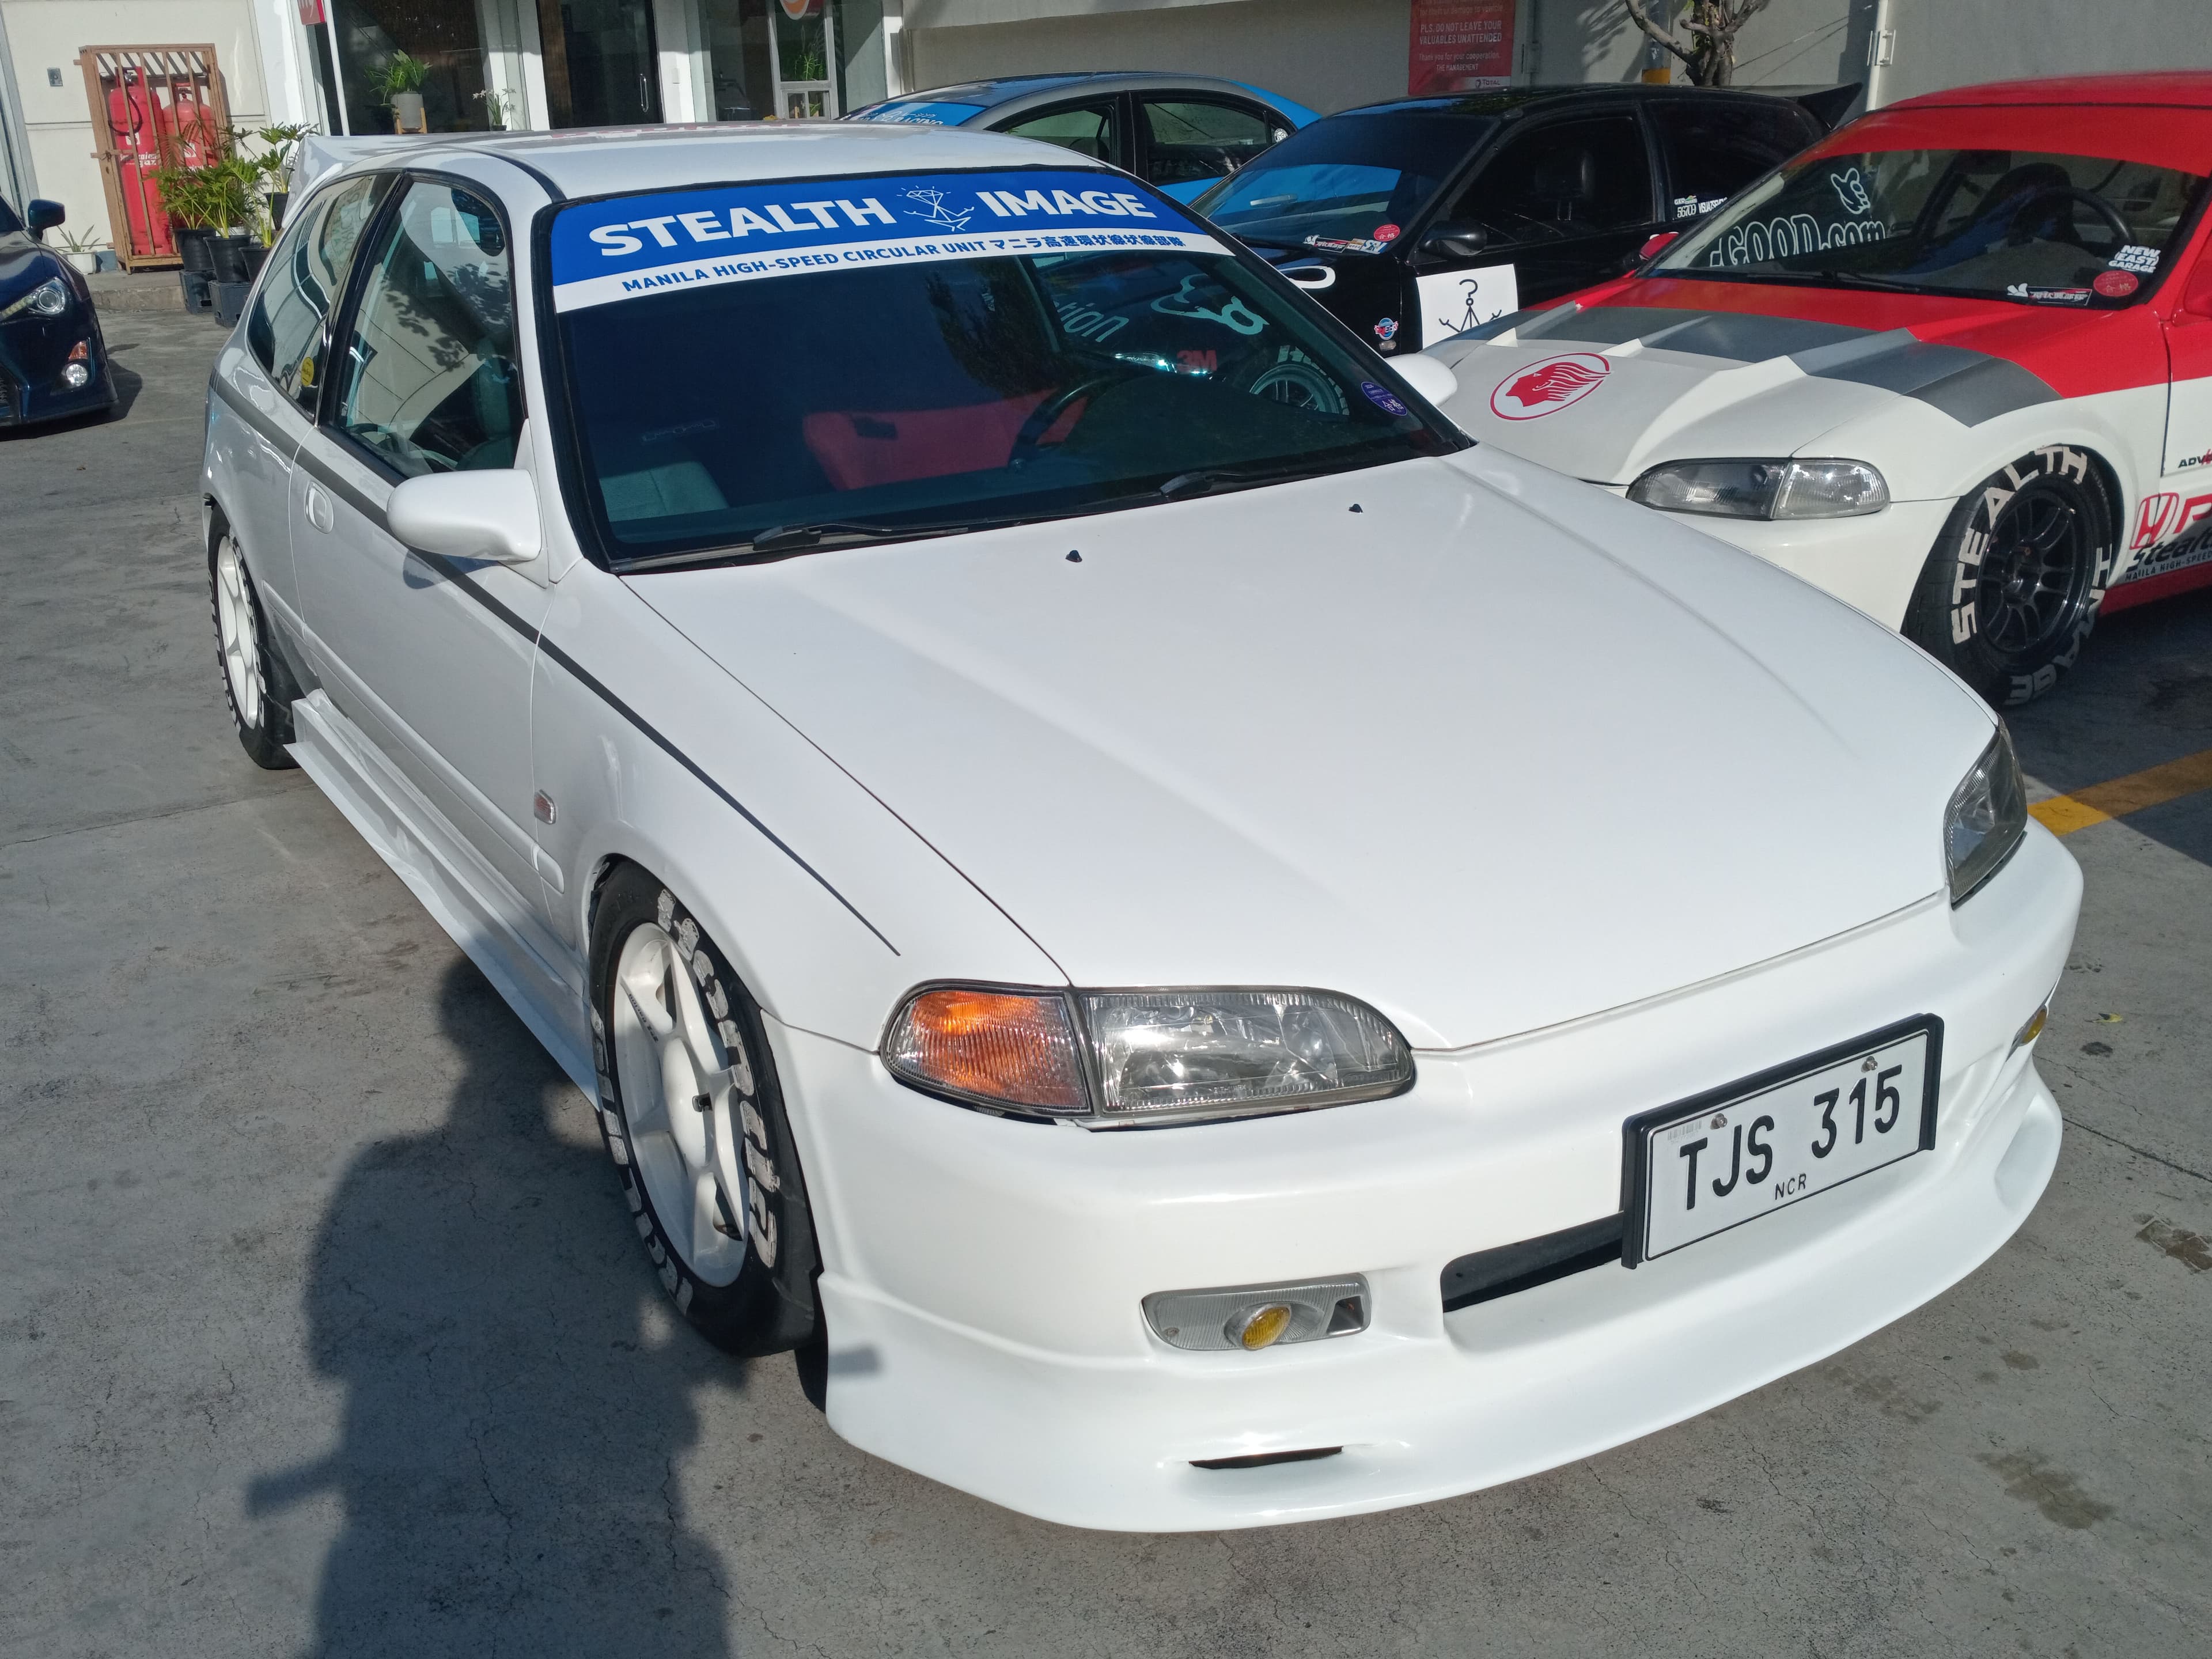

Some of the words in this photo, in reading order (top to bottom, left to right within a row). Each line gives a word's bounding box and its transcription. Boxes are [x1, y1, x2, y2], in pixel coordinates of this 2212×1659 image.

[1435, 23, 1444, 32] DO
[1445, 22, 1459, 32] NOT
[1460, 21, 1482, 31] LEAVE
[1484, 20, 1502, 30] YOUR
[1419, 35, 1456, 45] VALUABLES
[1457, 32, 1502, 44] UNATTENDED
[1677, 204, 1696, 218] 56709
[589, 198, 897, 256] STEALTH
[975, 190, 1157, 218] IMAGE
[2121, 245, 2161, 257] NEW
[622, 268, 710, 291] MANILA
[715, 252, 839, 277] HIGH-SPEED
[843, 244, 941, 262] CIRCULAR
[945, 241, 987, 254] UNIT
[2108, 260, 2156, 273] GARAGE
[1951, 445, 2088, 645] STEALTH
[2125, 566, 2156, 582] MANILA
[1679, 1115, 1775, 1210] TJS
[1811, 1064, 1902, 1159] 315
[1774, 1172, 1807, 1200] NCR
